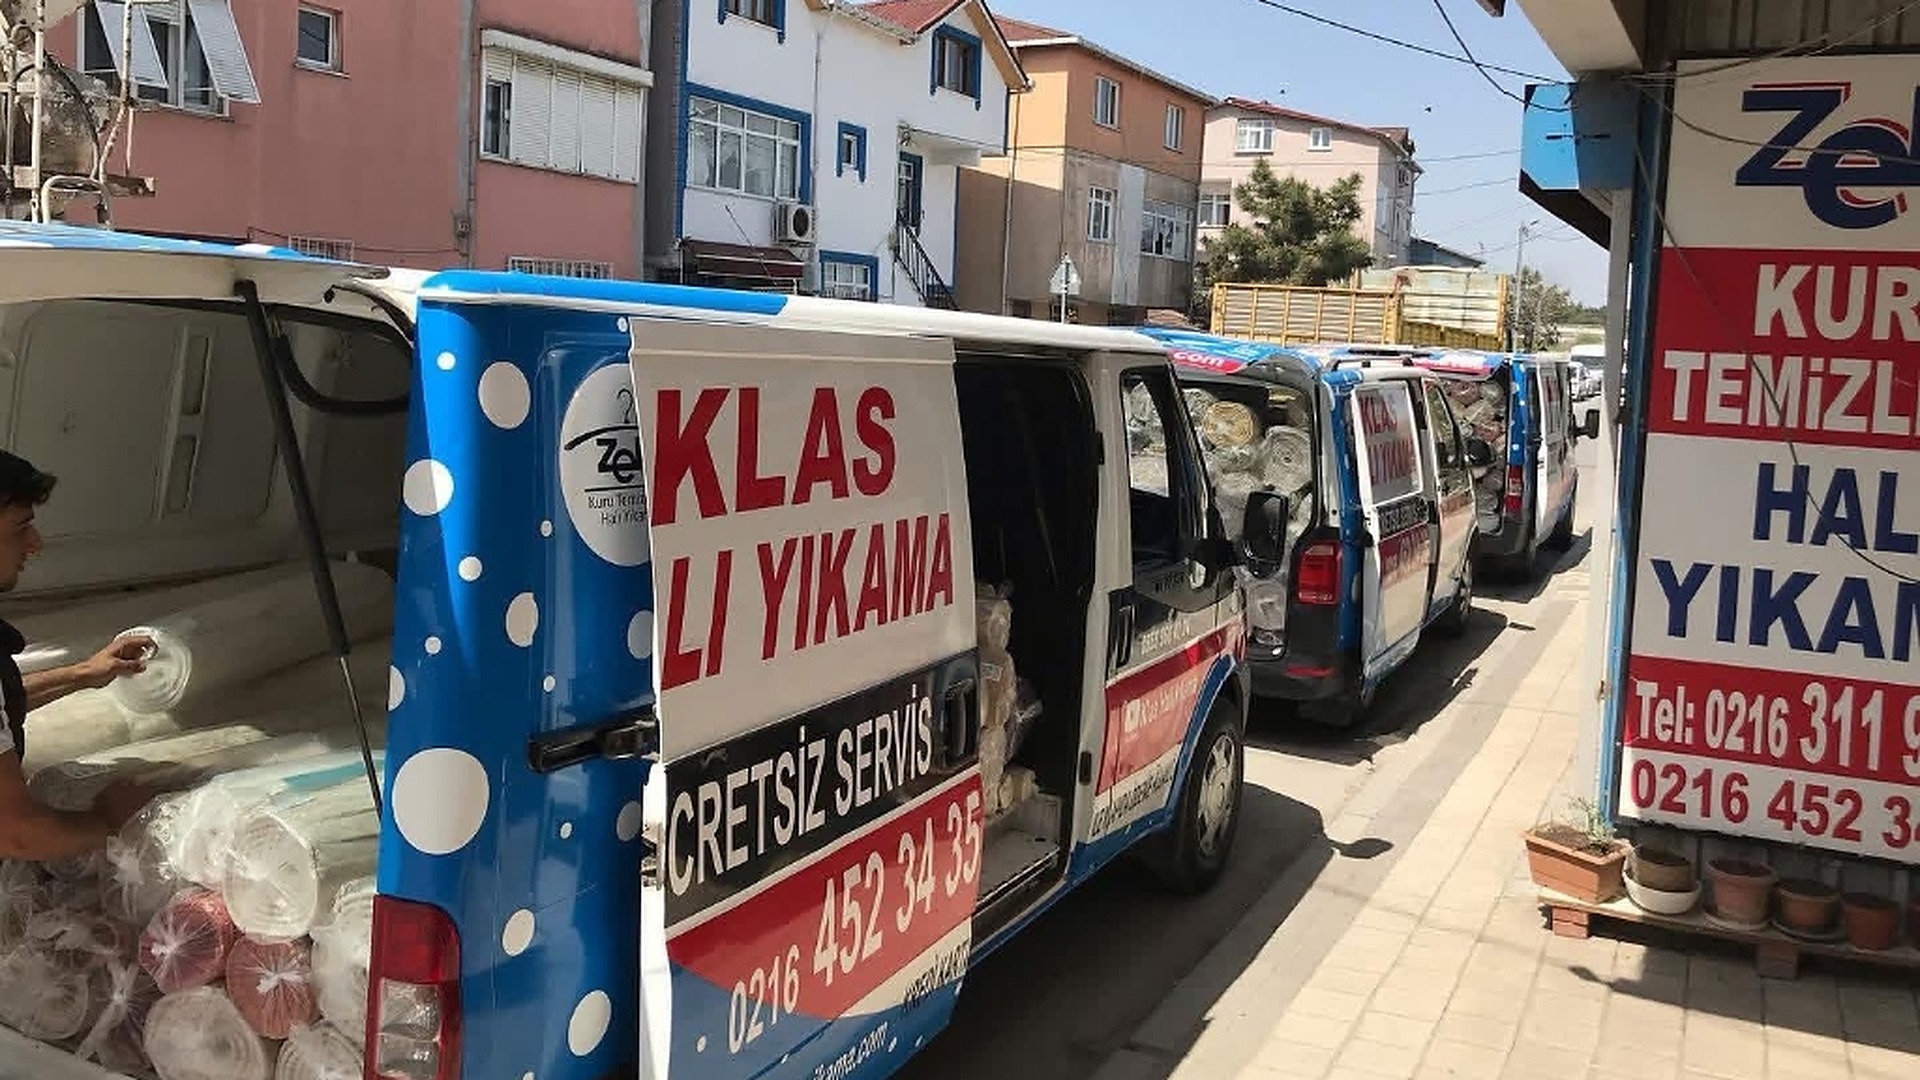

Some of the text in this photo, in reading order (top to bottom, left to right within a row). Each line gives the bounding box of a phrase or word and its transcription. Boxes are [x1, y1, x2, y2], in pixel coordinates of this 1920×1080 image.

[1736, 82, 1920, 229] Ze
[651, 387, 896, 527] KLAS
[1753, 463, 1920, 554] HAL
[661, 513, 954, 691] LI YIKAMA
[669, 725, 826, 897] CRETSİZ
[835, 684, 932, 816] SERVİS
[1636, 681, 1693, 745] Tel:
[1705, 689, 1788, 759] 0216
[1800, 682, 1883, 772] 311
[1631, 759, 1920, 850] 0216 452 3
[728, 945, 800, 1055] 0216
[812, 851, 884, 987] 452
[896, 818, 935, 933] 34
[945, 791, 981, 897] 35
